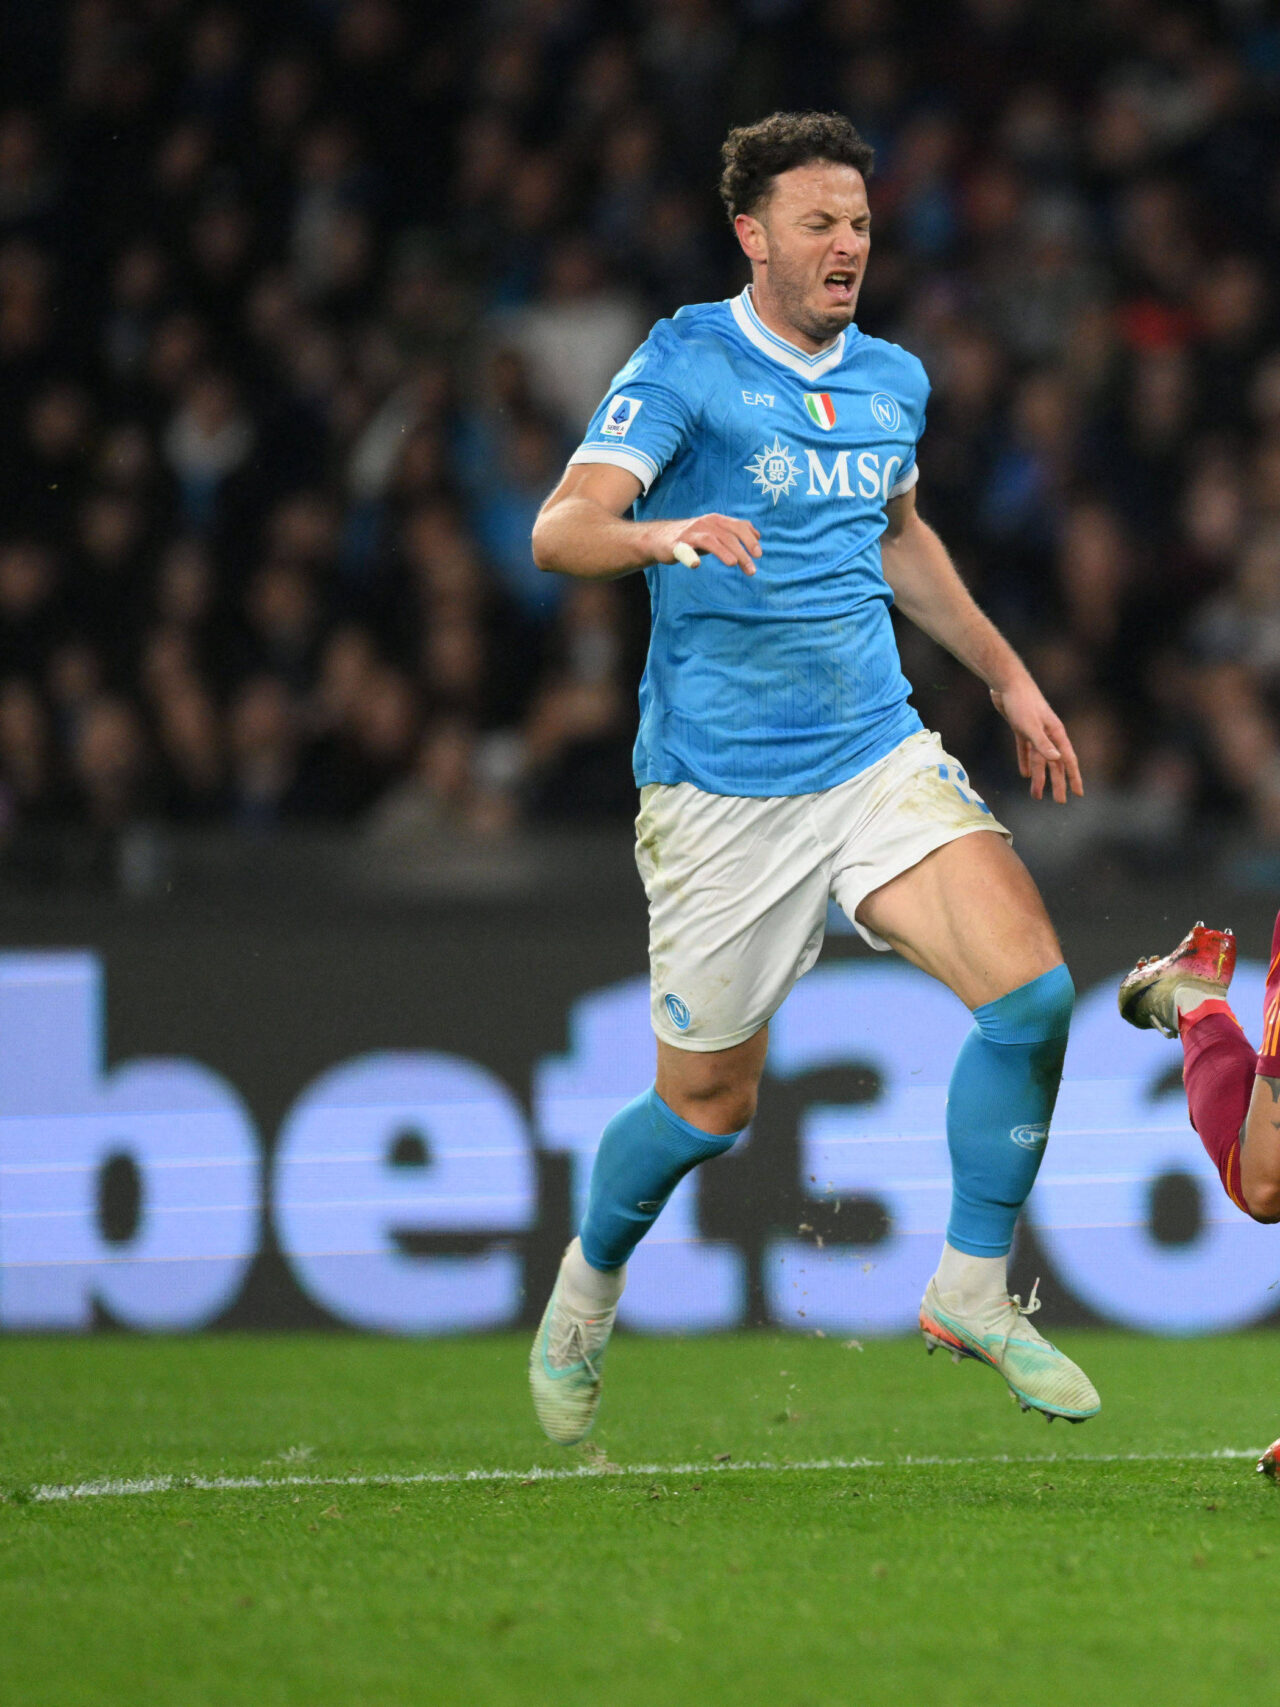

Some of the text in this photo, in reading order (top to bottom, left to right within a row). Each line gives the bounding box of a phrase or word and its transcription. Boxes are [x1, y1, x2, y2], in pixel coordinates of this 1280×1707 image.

[741, 390, 775, 408] EA7
[877, 403, 892, 422] N
[804, 449, 902, 500] MSC
